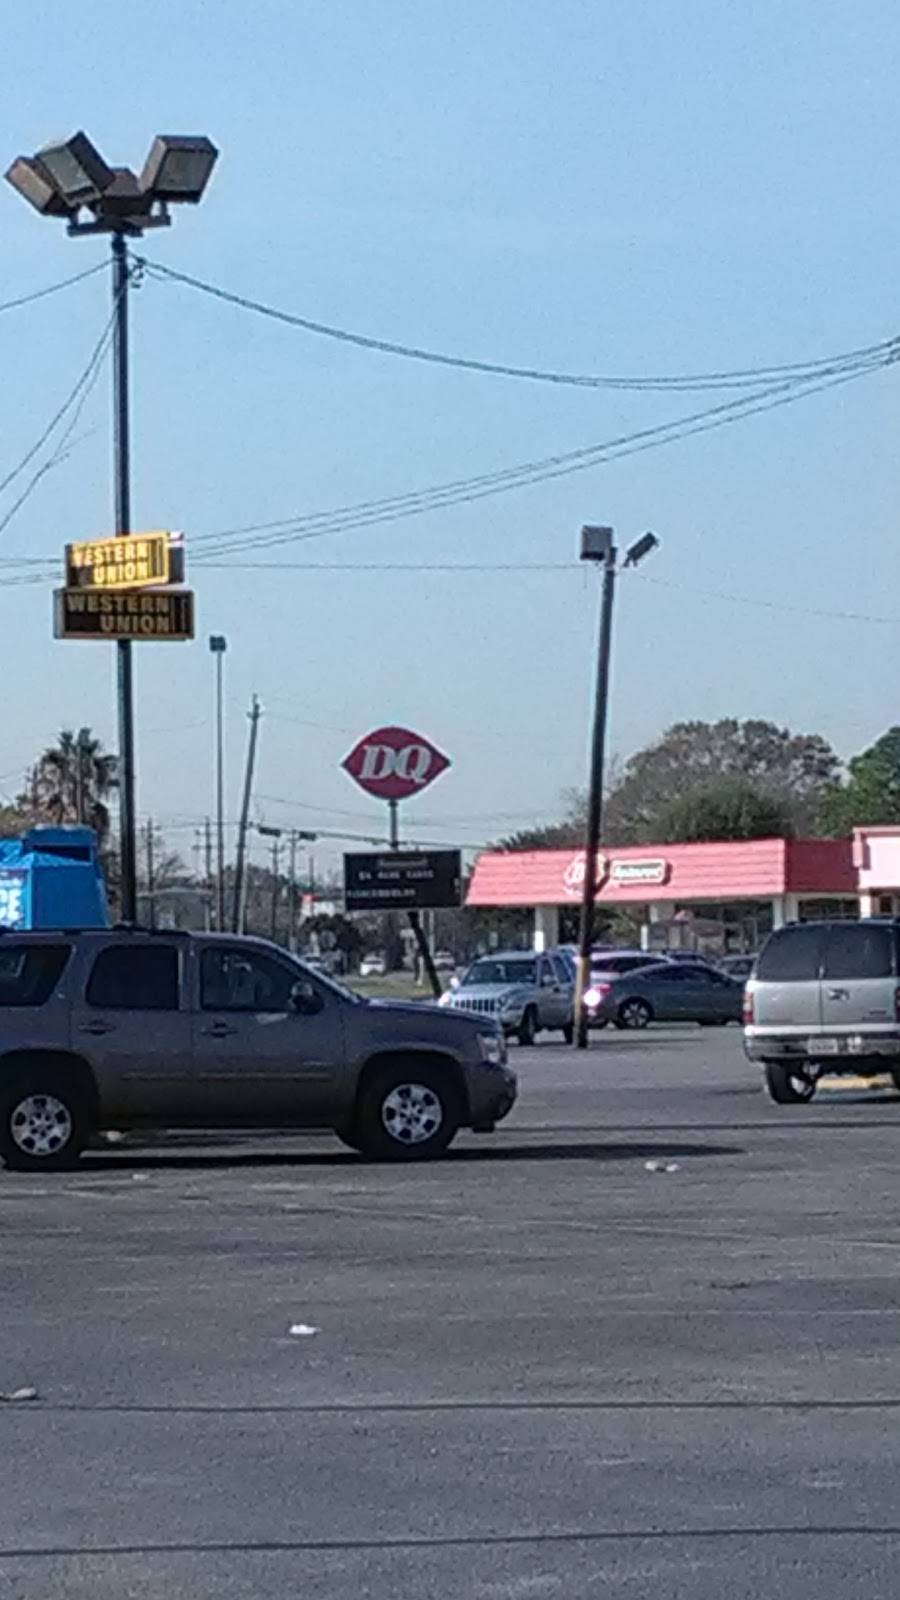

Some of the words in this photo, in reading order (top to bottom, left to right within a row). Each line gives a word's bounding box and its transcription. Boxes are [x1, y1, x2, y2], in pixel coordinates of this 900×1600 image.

[71, 542, 149, 567] WESTERN
[93, 561, 149, 584] UNION
[67, 594, 170, 613] WESTERN
[100, 615, 170, 633] UNION
[358, 744, 432, 784] DQ
